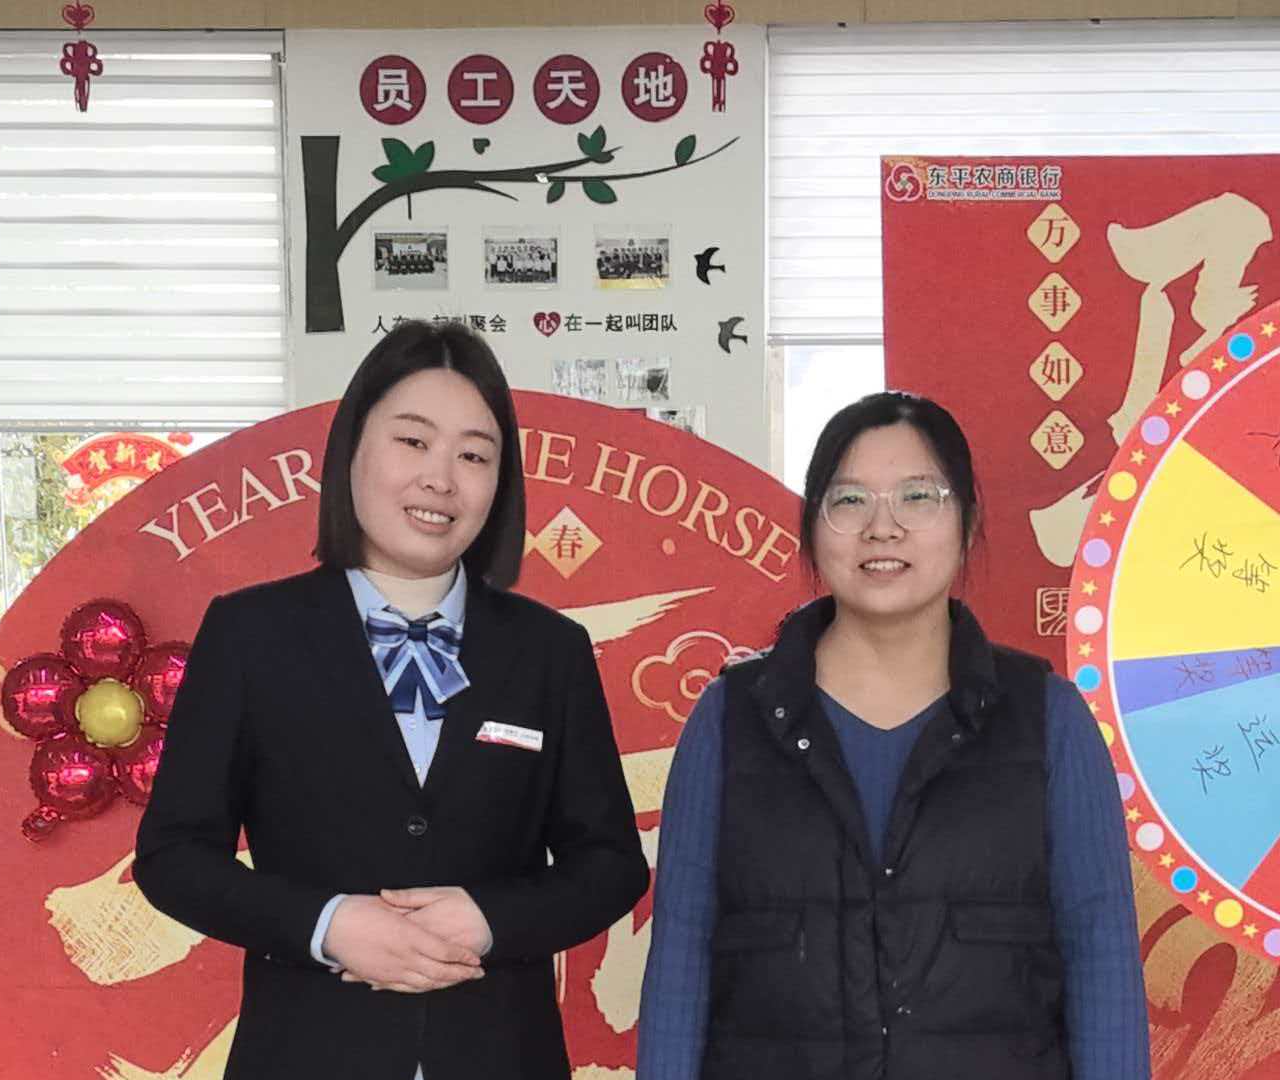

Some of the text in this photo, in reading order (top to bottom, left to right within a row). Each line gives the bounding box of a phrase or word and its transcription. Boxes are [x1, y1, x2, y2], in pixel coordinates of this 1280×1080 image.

[373, 65, 676, 111] 员工天地
[928, 167, 1061, 188] 东平农商银行
[537, 313, 677, 335] 心在一起叫团队
[1040, 217, 1073, 454] 万事如意
[139, 448, 321, 563] YEAR
[584, 442, 802, 583] HORSE
[548, 524, 584, 560] 春
